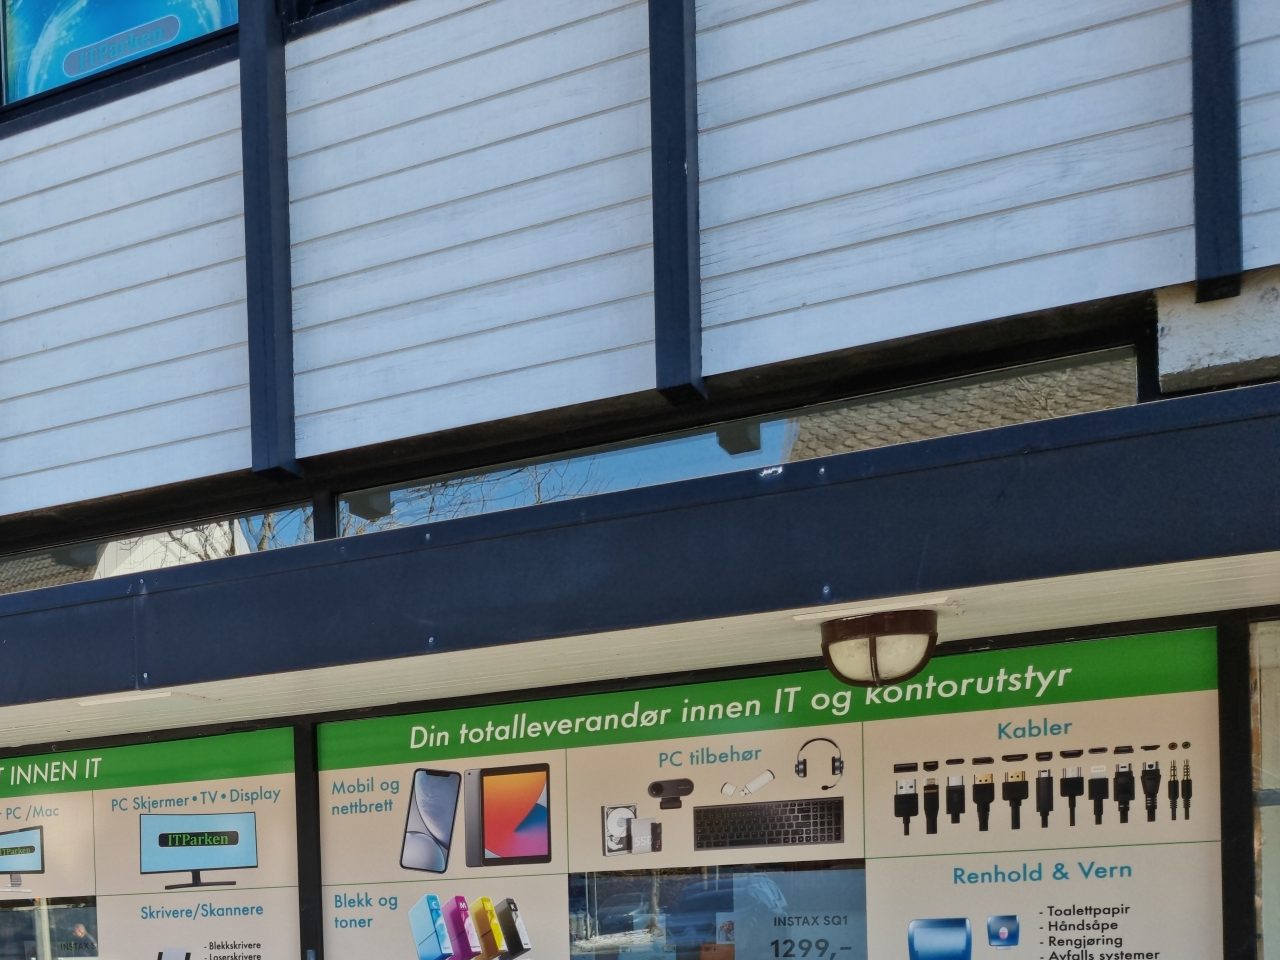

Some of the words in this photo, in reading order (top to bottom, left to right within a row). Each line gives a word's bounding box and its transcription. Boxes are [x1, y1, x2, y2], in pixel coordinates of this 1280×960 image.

[410, 725, 450, 749] Din
[460, 702, 671, 744] totalleverandør
[682, 698, 762, 723] innen
[774, 687, 801, 714] IT
[811, 690, 852, 716] og
[865, 665, 1072, 705] kontorutstyr
[998, 718, 1072, 740] Kabler
[658, 751, 683, 768] PC
[690, 745, 762, 766] tilbehør
[11, 760, 77, 786] INNEN
[85, 758, 102, 779] IT
[331, 777, 374, 795] Mobil
[380, 780, 400, 795] og
[111, 798, 128, 812] PC
[133, 796, 189, 813] Skjermer
[200, 790, 219, 805] TV
[230, 786, 281, 805] Display
[331, 798, 394, 816] nettbrett
[6, 807, 22, 820] PC
[168, 834, 229, 847] ITParken
[953, 863, 1043, 885] Renhold
[1052, 863, 1070, 881] &
[1078, 861, 1133, 880] Vern
[334, 892, 373, 910] Blekk
[378, 896, 398, 911] og
[140, 903, 264, 921] Skrivere/Skannere
[1047, 904, 1131, 919] Toalettpapir
[334, 916, 373, 929] toner
[773, 916, 820, 927] INSTAX
[823, 915, 848, 926] SQ1
[1048, 919, 1119, 934] Håndsåpe
[209, 940, 262, 951] Blekkskrivere
[1048, 935, 1123, 950] Rengjøring
